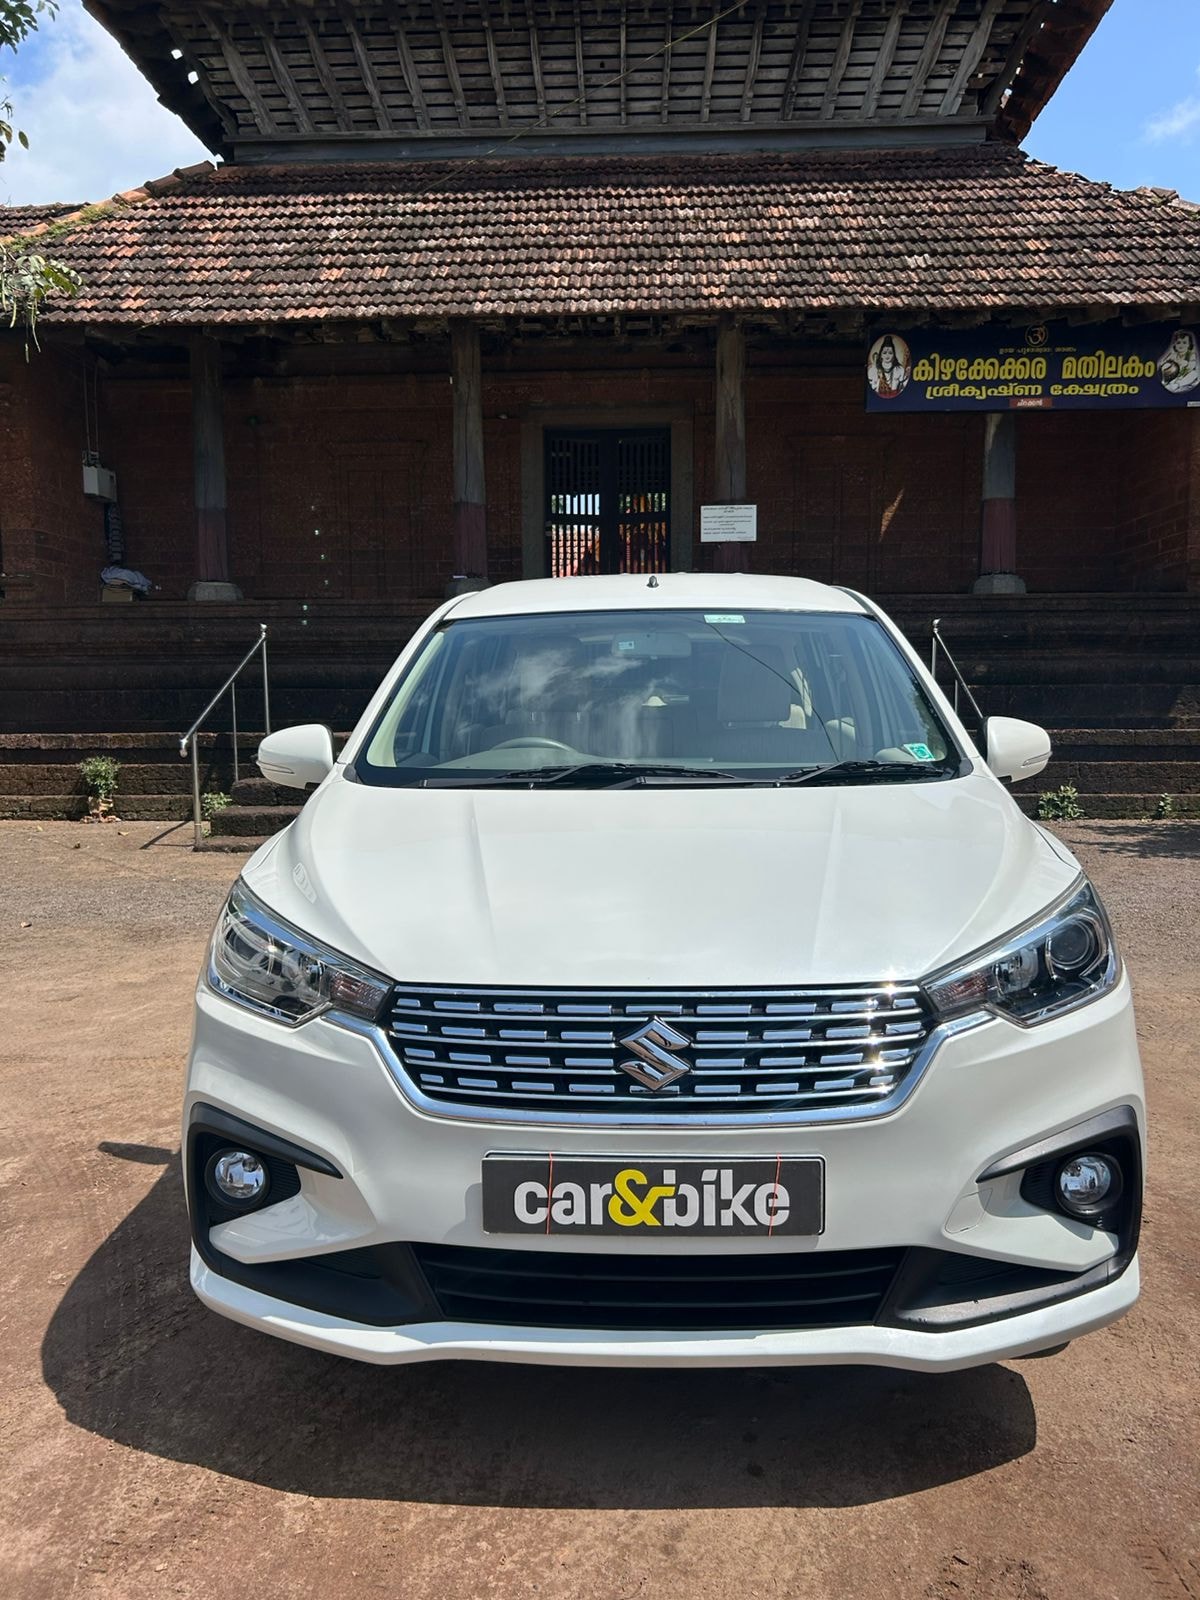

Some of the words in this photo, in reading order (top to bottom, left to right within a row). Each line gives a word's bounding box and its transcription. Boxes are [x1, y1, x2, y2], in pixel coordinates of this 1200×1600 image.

[912, 352, 1048, 381] കിഴക്കേക്കര
[1061, 350, 1156, 379] മതിലകം
[926, 383, 1043, 400] ശ്രീകൃഷ്ണ
[1049, 383, 1140, 398] ക്ഷേത്രം
[513, 1168, 791, 1228] car&bike
